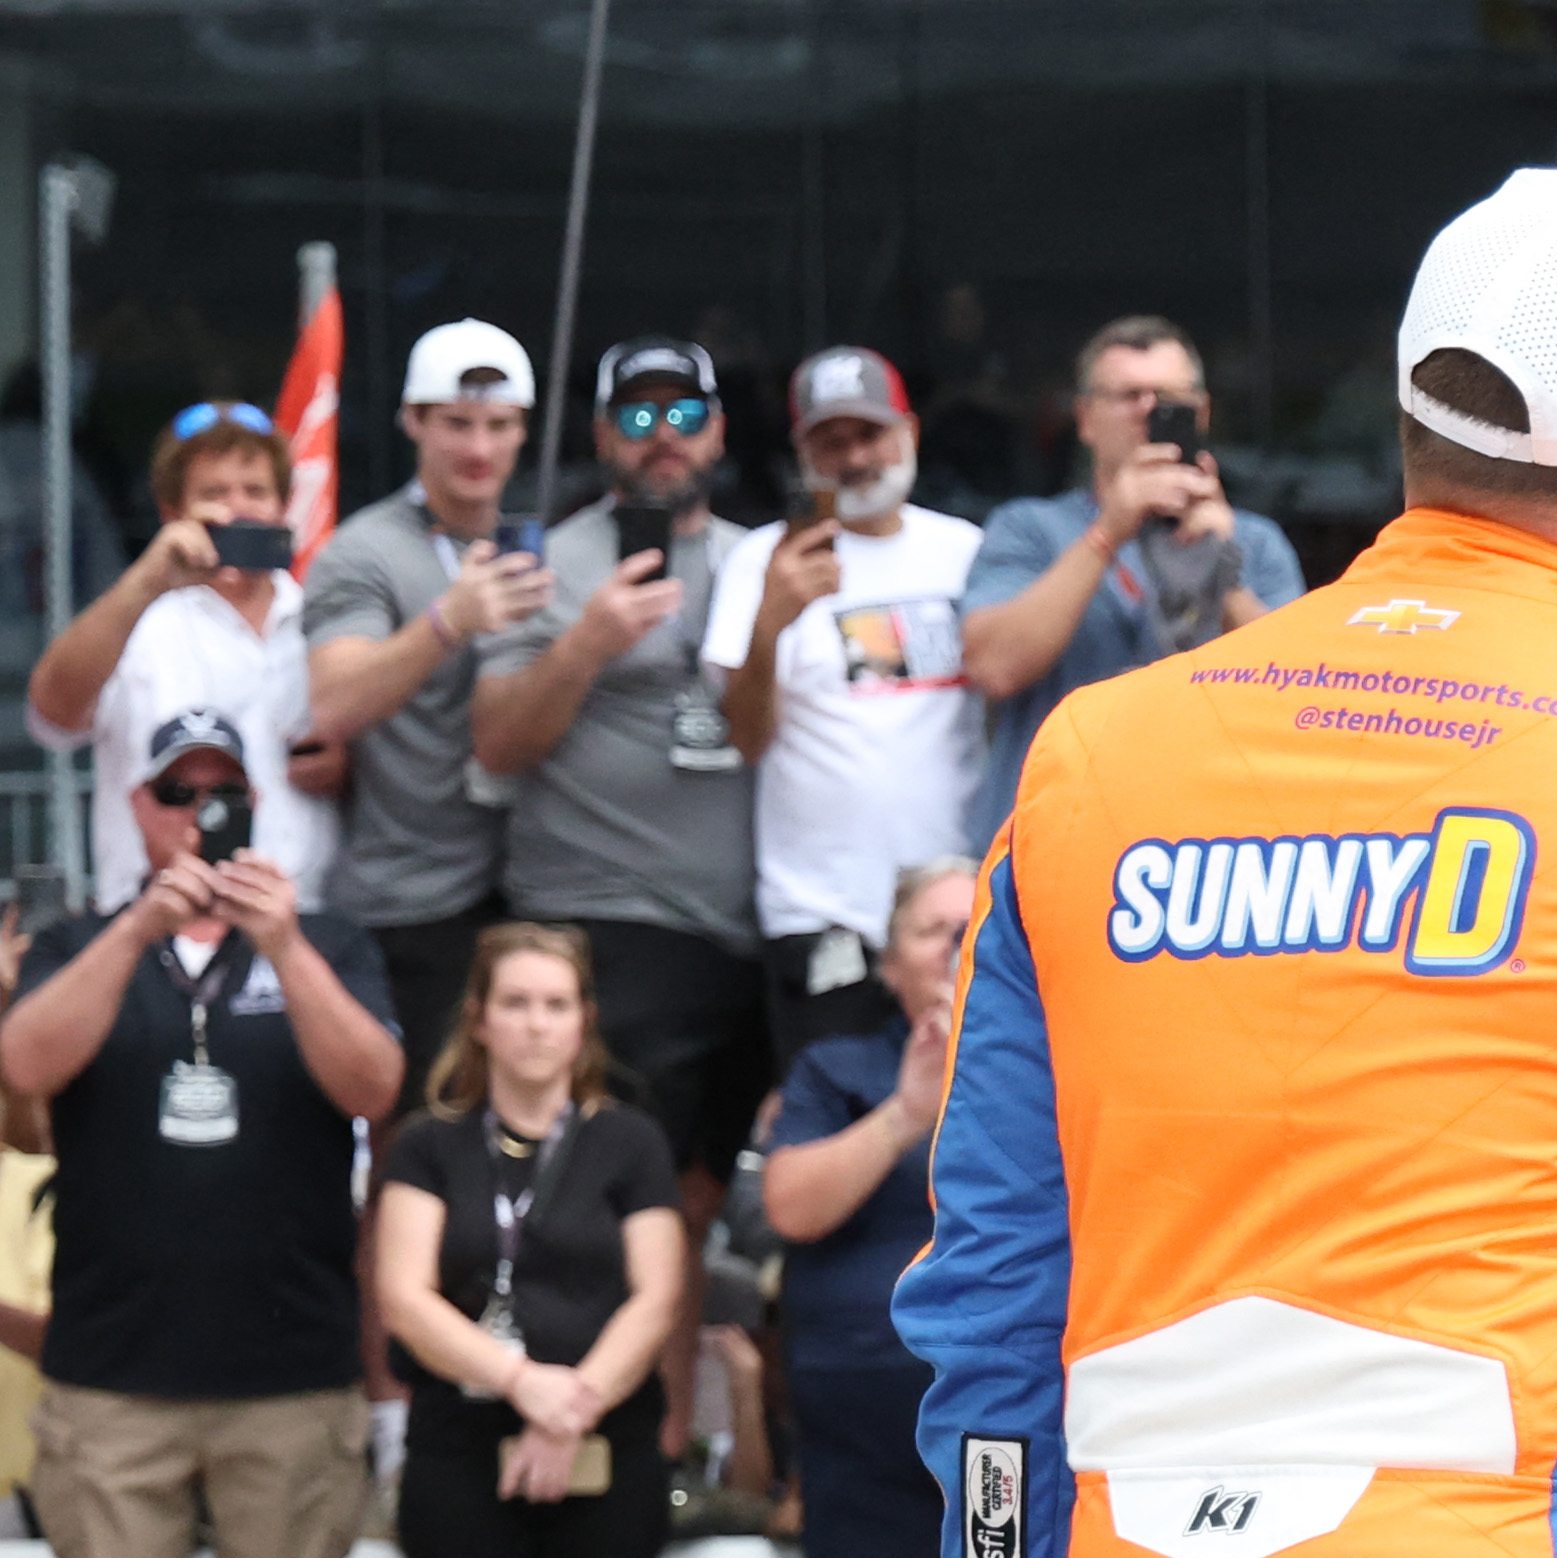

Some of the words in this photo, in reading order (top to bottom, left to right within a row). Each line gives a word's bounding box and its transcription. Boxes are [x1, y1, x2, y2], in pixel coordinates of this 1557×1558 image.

[1295, 706, 1502, 748] @stenhousejr
[982, 1453, 992, 1519] MANUFACTURER
[992, 1466, 1002, 1511] CERTIFIED
